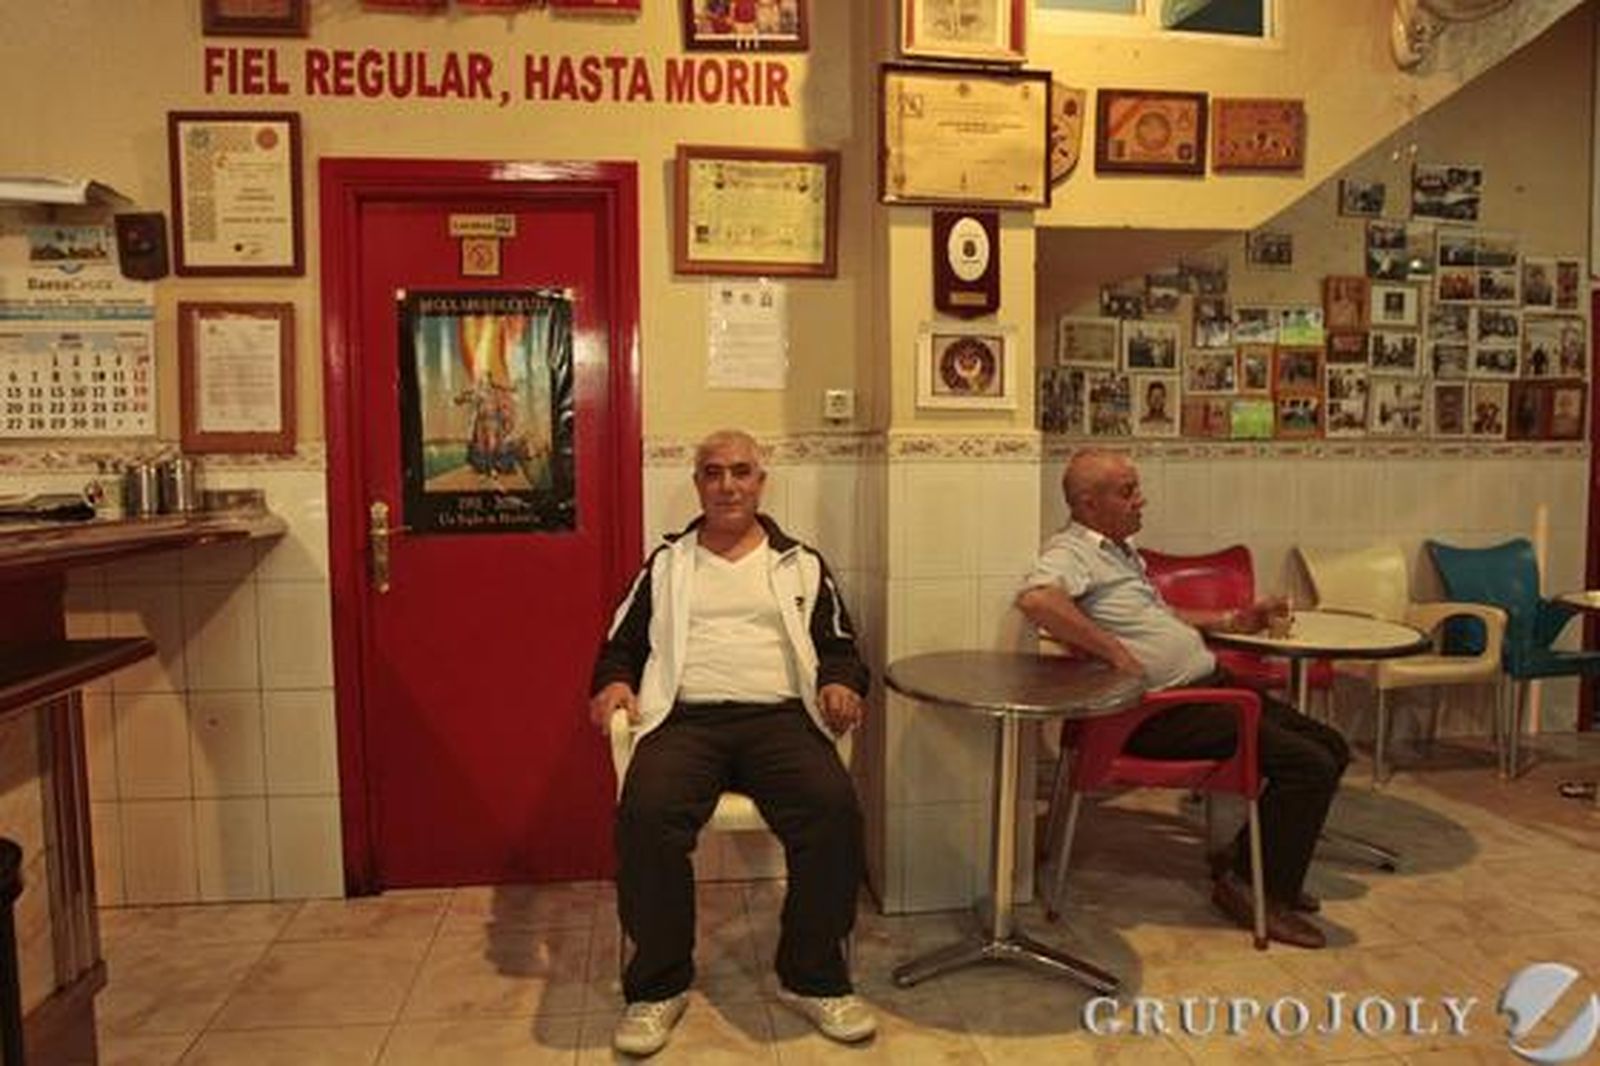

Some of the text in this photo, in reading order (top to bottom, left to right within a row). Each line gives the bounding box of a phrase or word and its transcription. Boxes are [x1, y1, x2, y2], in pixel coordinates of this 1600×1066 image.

[205, 47, 289, 94] FIEL
[525, 54, 654, 102] HASTA
[665, 58, 790, 106] MORIR
